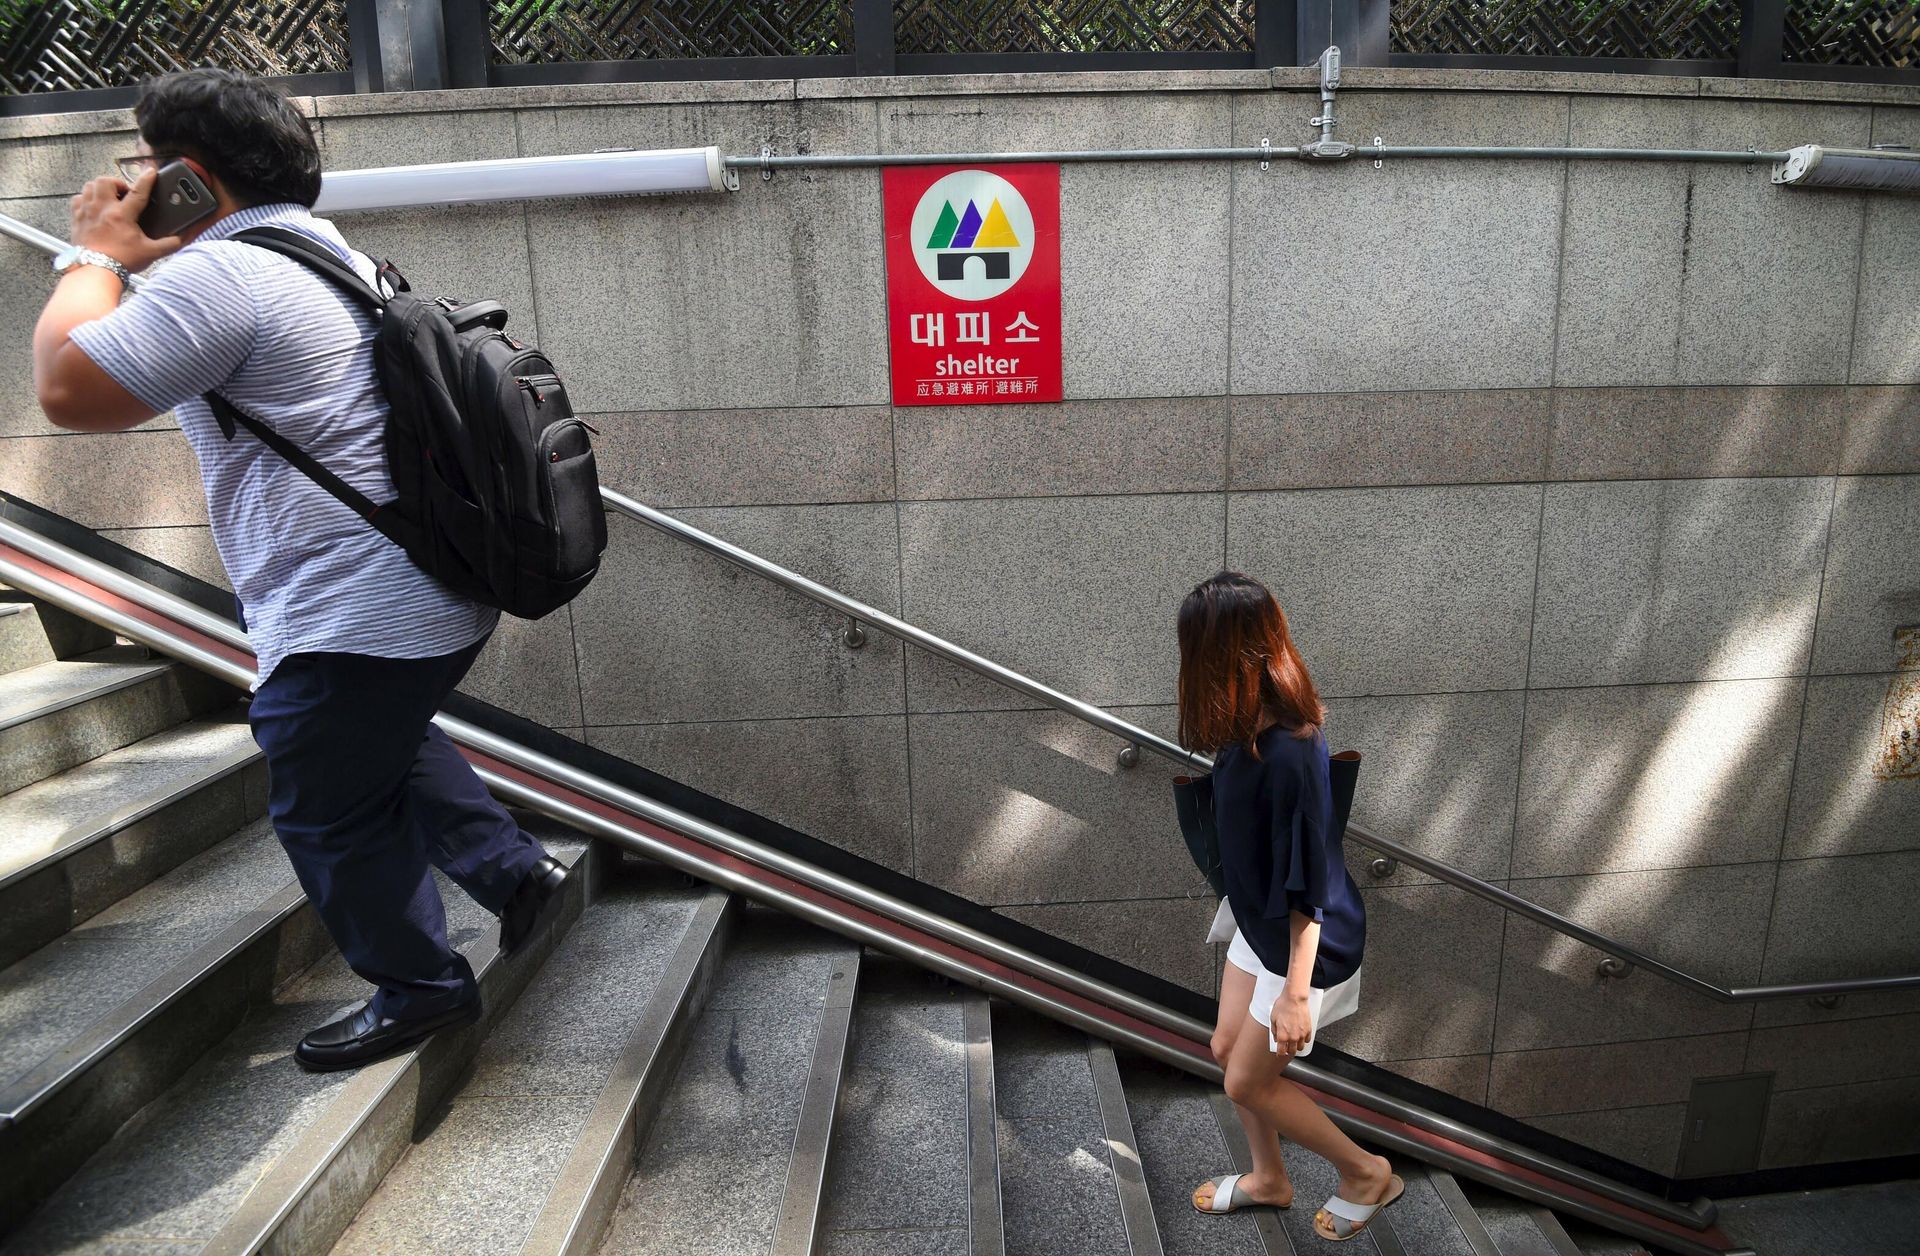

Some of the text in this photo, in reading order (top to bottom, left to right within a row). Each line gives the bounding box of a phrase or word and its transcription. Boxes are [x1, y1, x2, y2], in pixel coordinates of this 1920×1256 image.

[910, 311, 1040, 347] 대피소
[935, 353, 1020, 376] shelter
[916, 379, 1039, 397] 应急避难所 避難所
